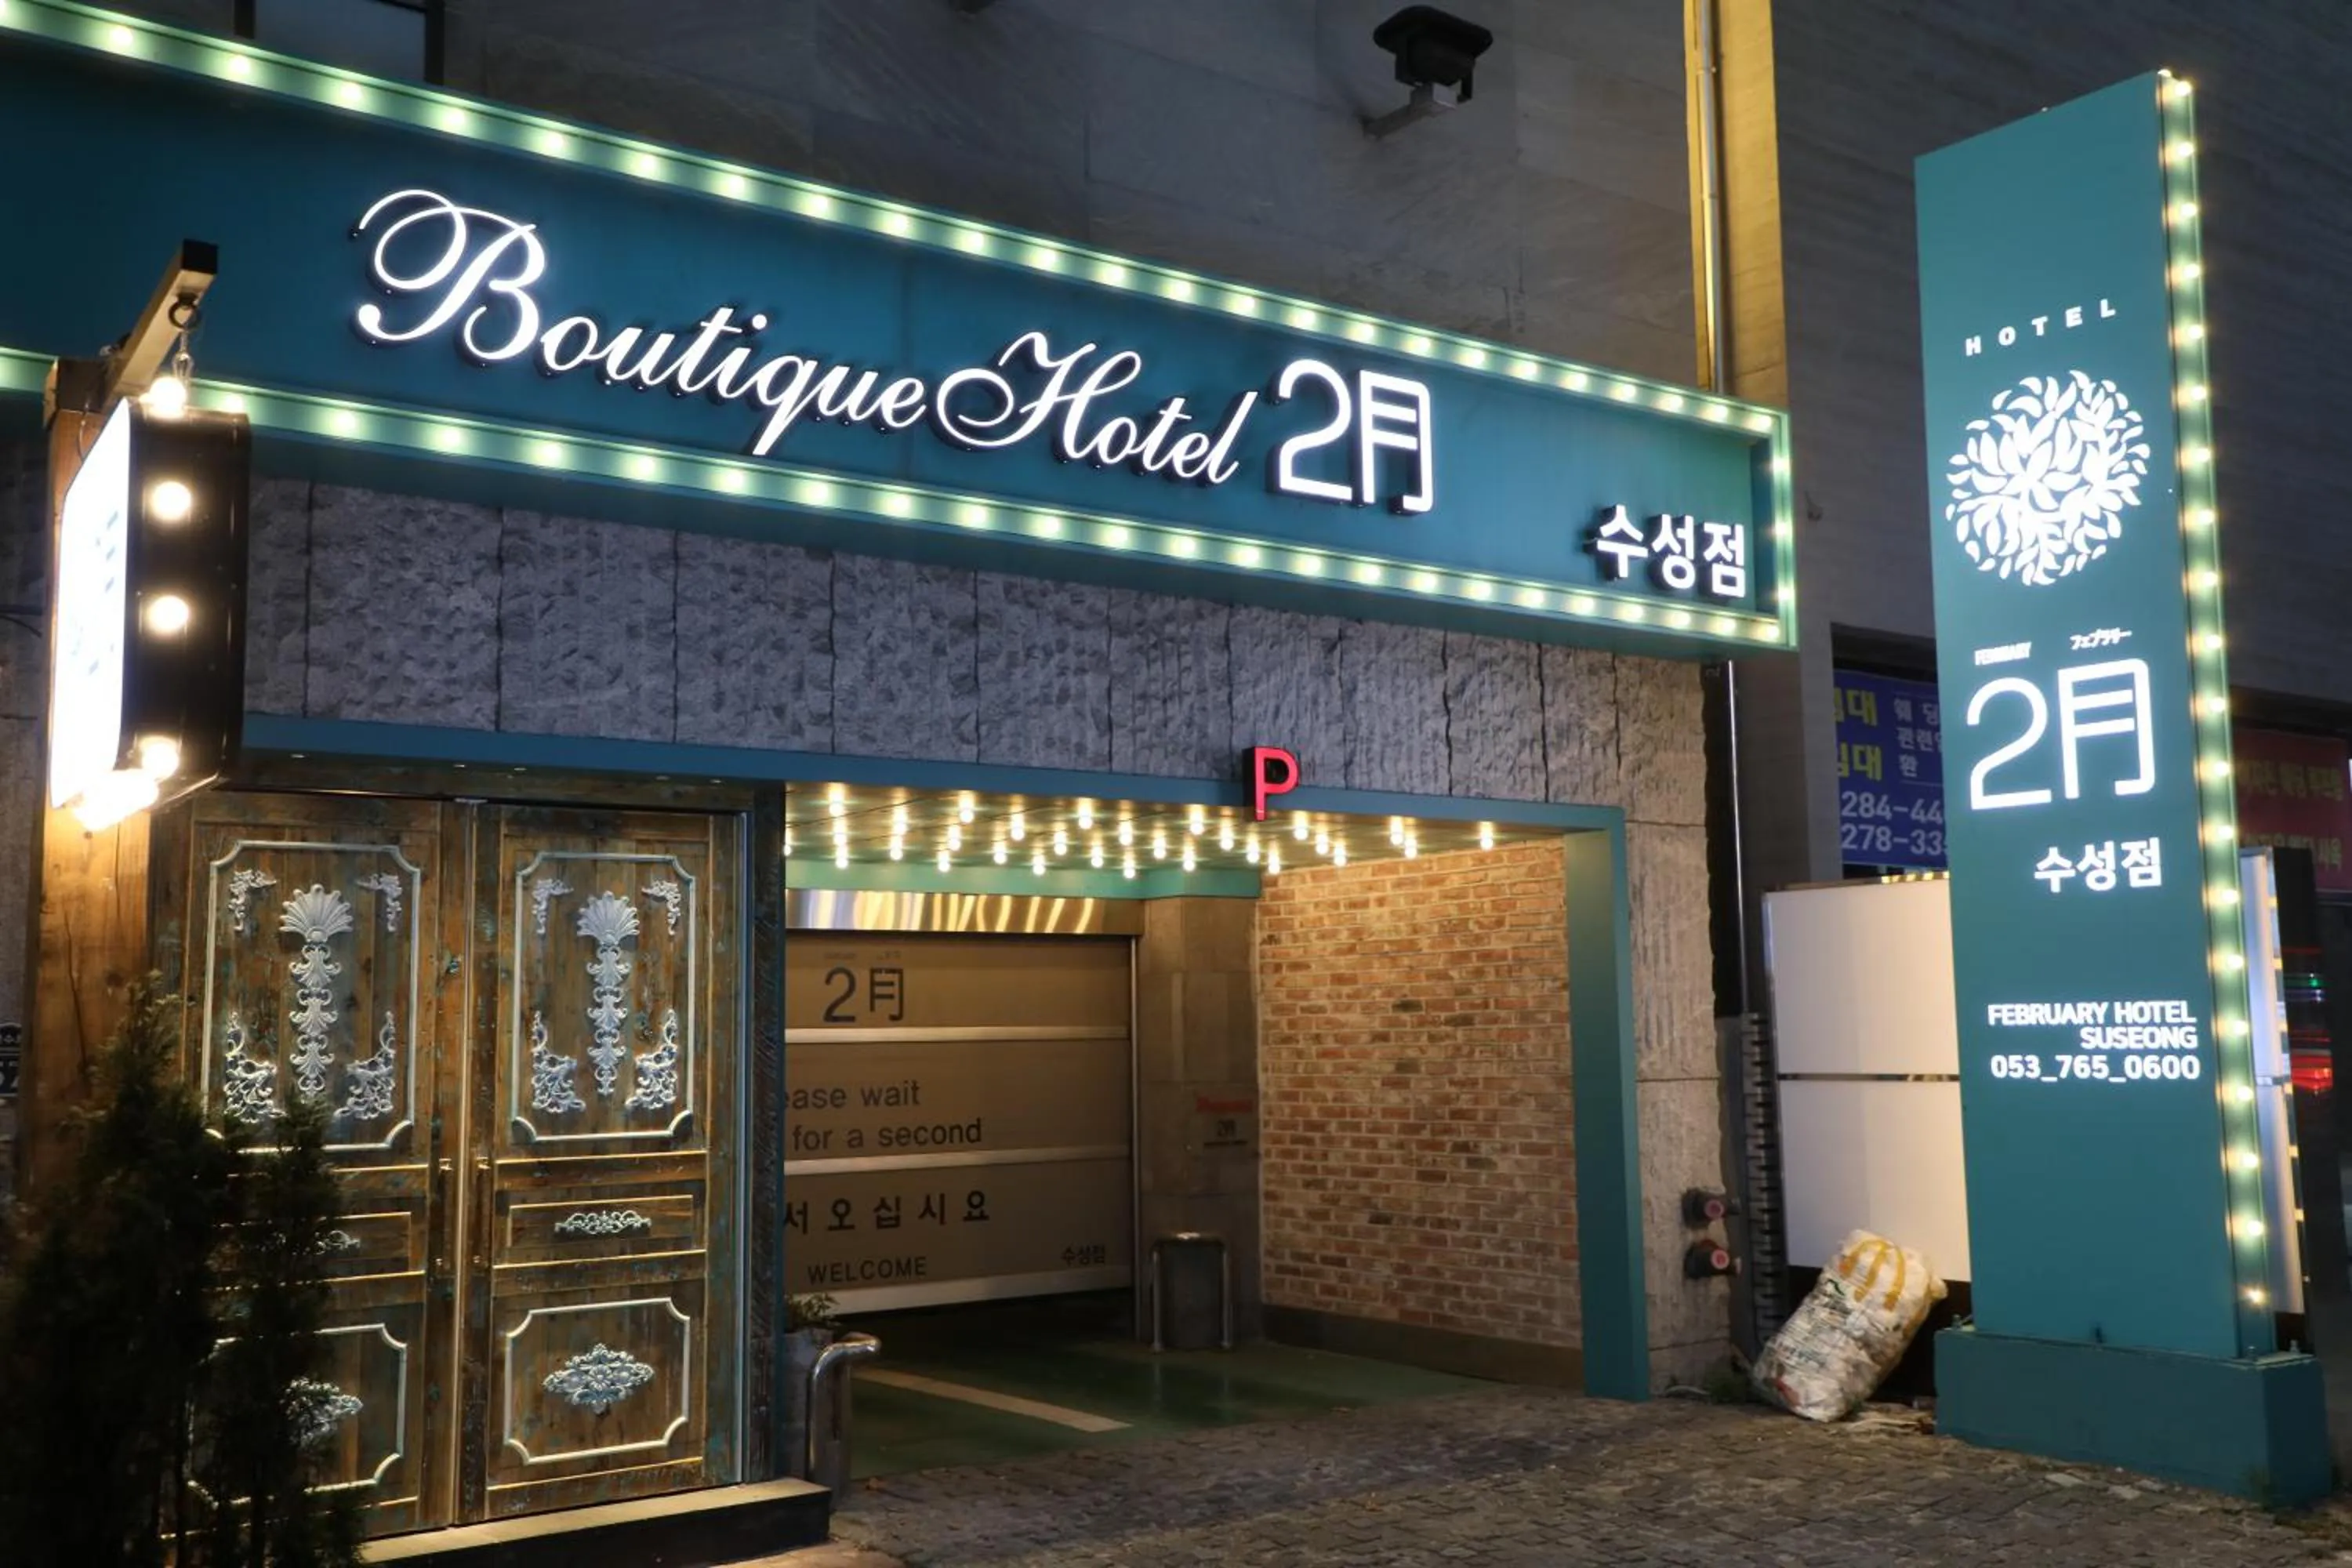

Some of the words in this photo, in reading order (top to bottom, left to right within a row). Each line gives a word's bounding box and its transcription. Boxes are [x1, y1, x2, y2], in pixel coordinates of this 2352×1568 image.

[358, 189, 926, 456] Boutique
[936, 332, 1258, 484] Hotel
[1965, 299, 2116, 356] HOTEL
[1595, 504, 1747, 598] 수성점
[1966, 658, 2156, 811] 2月
[1254, 746, 1298, 821] P
[1841, 822, 1947, 856] 278-33
[2034, 837, 2161, 893] 수성점
[1987, 1002, 2109, 1026] FEBRUARY
[2114, 1000, 2197, 1024] HOTEL
[2080, 1025, 2198, 1050] SUSEONG
[1991, 1054, 2201, 1083] 053_765_0600
[860, 1080, 920, 1107] wait
[792, 1124, 833, 1152] for
[847, 1128, 863, 1149] a
[877, 1117, 982, 1148] second
[807, 1257, 927, 1284] WELCOME
